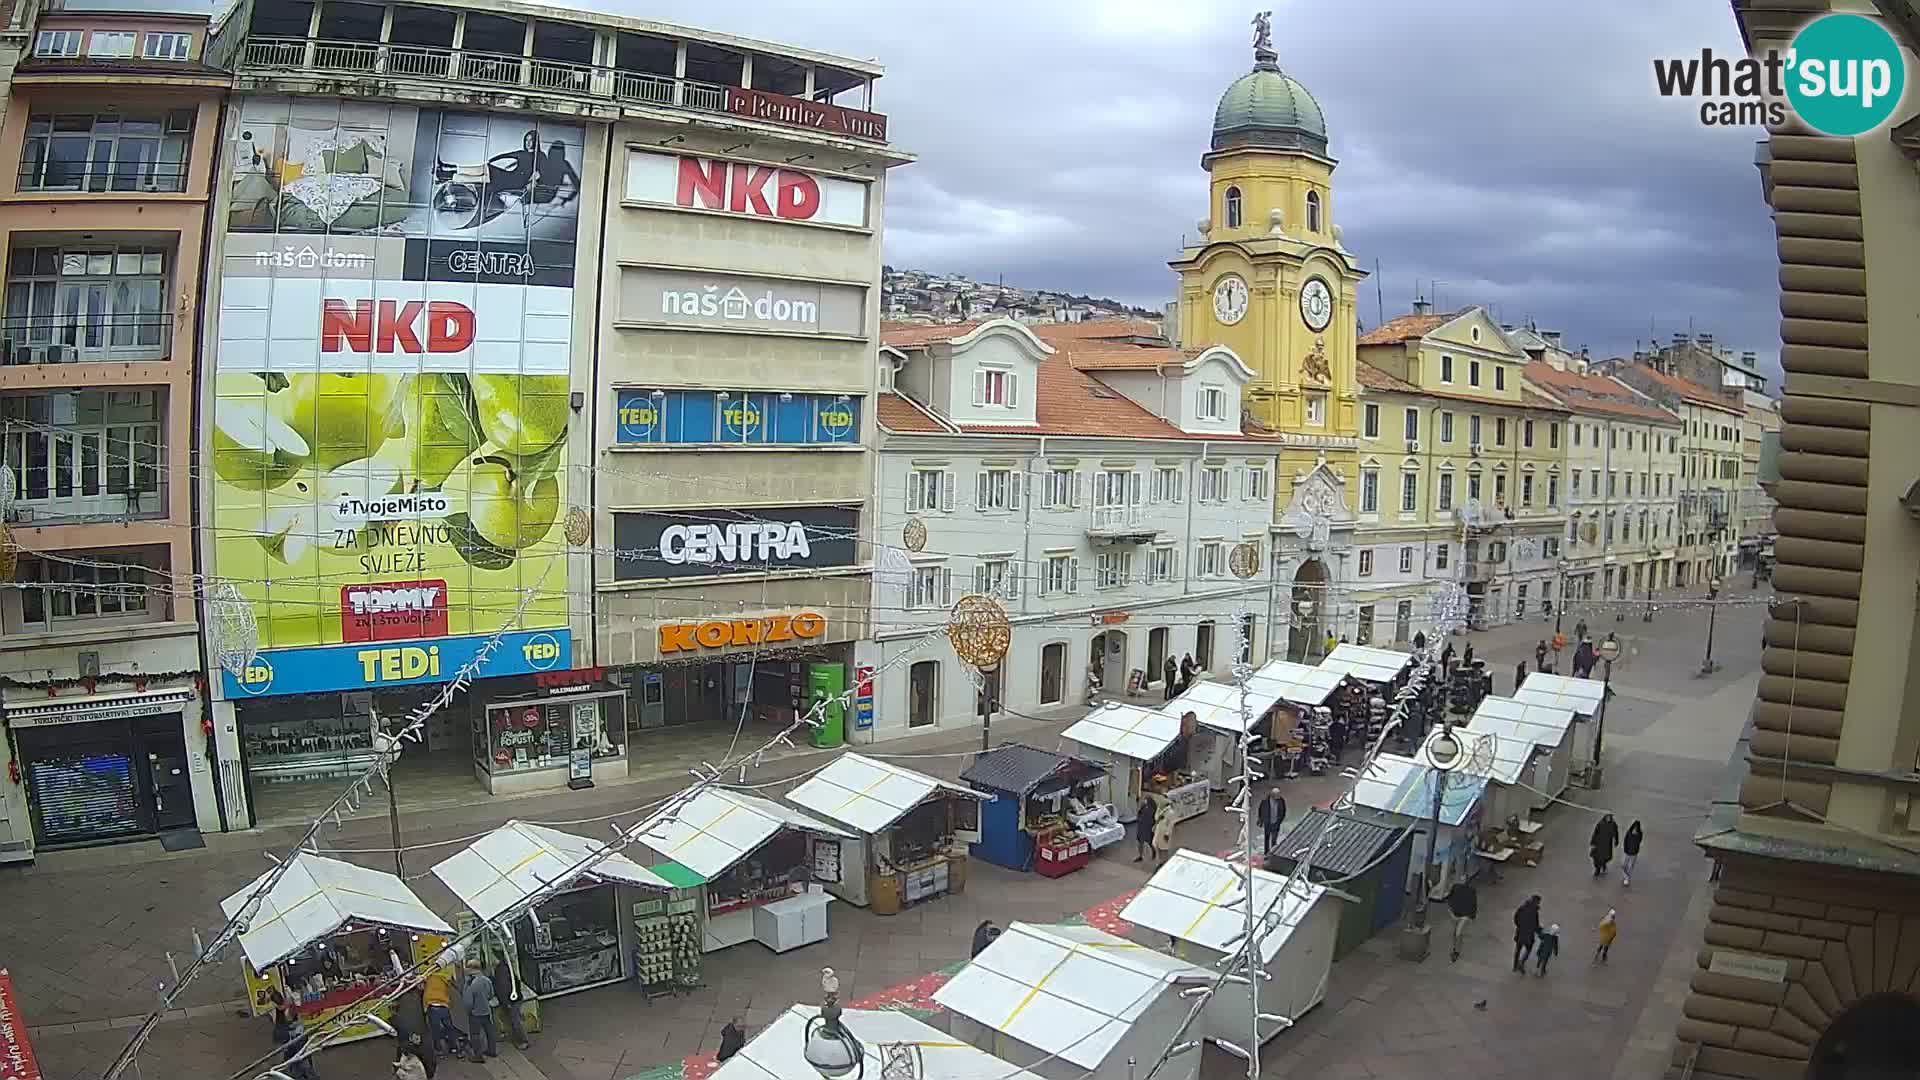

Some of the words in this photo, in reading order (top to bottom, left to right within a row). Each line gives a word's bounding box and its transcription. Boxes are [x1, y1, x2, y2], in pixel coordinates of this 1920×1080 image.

[676, 158, 820, 219] NKD
[448, 250, 535, 276] CENTRA
[662, 285, 717, 318] naš
[754, 290, 817, 323] dom
[321, 299, 477, 354] NKD
[338, 497, 446, 517] #TvojeMisto
[333, 528, 358, 549] ZA
[367, 525, 451, 548] DNEVNO
[659, 521, 811, 565] CENTRA
[359, 548, 426, 575] SVJEŽE
[349, 587, 440, 614] TOMMY
[522, 633, 560, 661] TEDi
[659, 612, 825, 654] KORZO
[237, 664, 273, 685] EDi
[358, 646, 440, 682] TEDi
